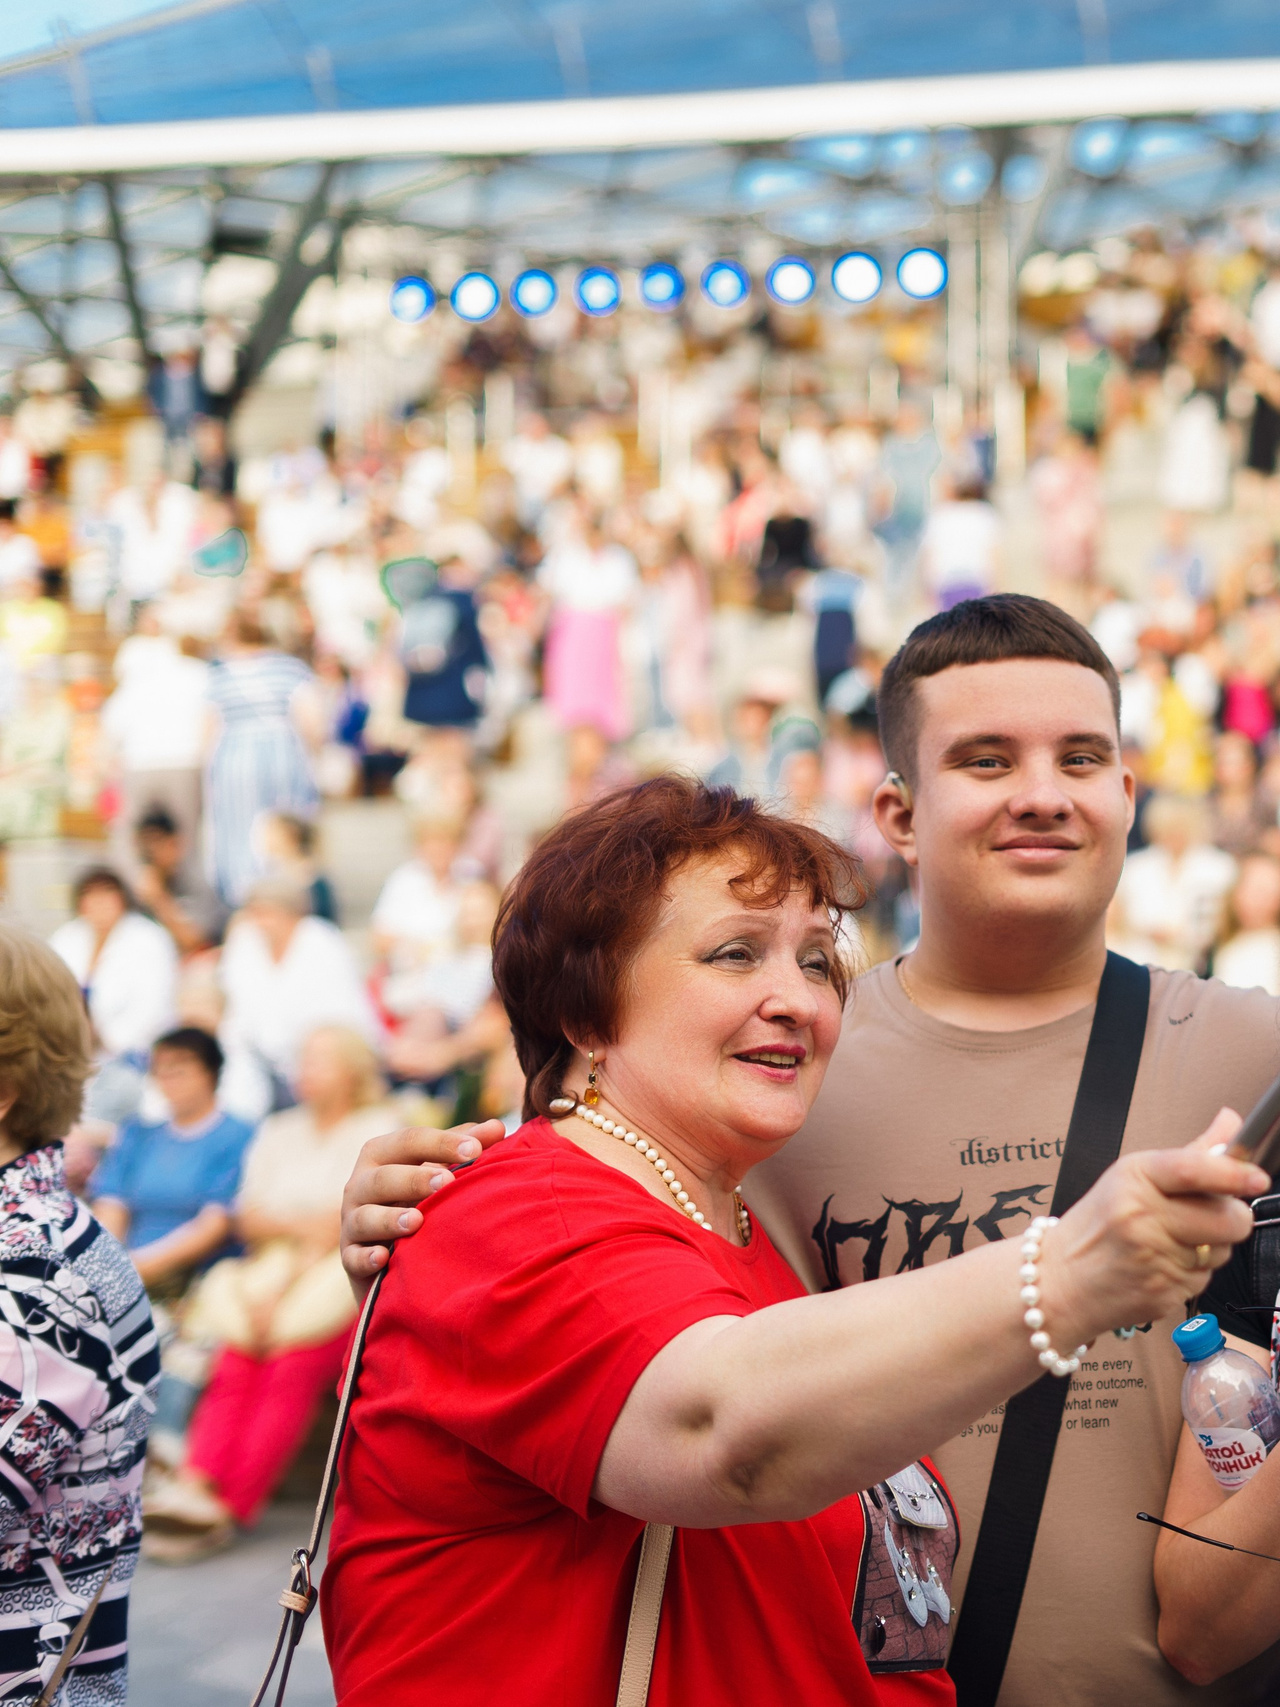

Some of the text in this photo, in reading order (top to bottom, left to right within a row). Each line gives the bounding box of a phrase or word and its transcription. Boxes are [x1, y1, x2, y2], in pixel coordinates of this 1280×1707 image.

[949, 1136, 1066, 1167] district
[1081, 1360, 1133, 1373] me every
[1096, 1377, 1148, 1390] outcome,
[1065, 1397, 1092, 1411] what
[1095, 1398, 1119, 1409] new
[977, 1423, 998, 1437] you
[1066, 1419, 1078, 1430] or
[1080, 1416, 1110, 1429] learn
